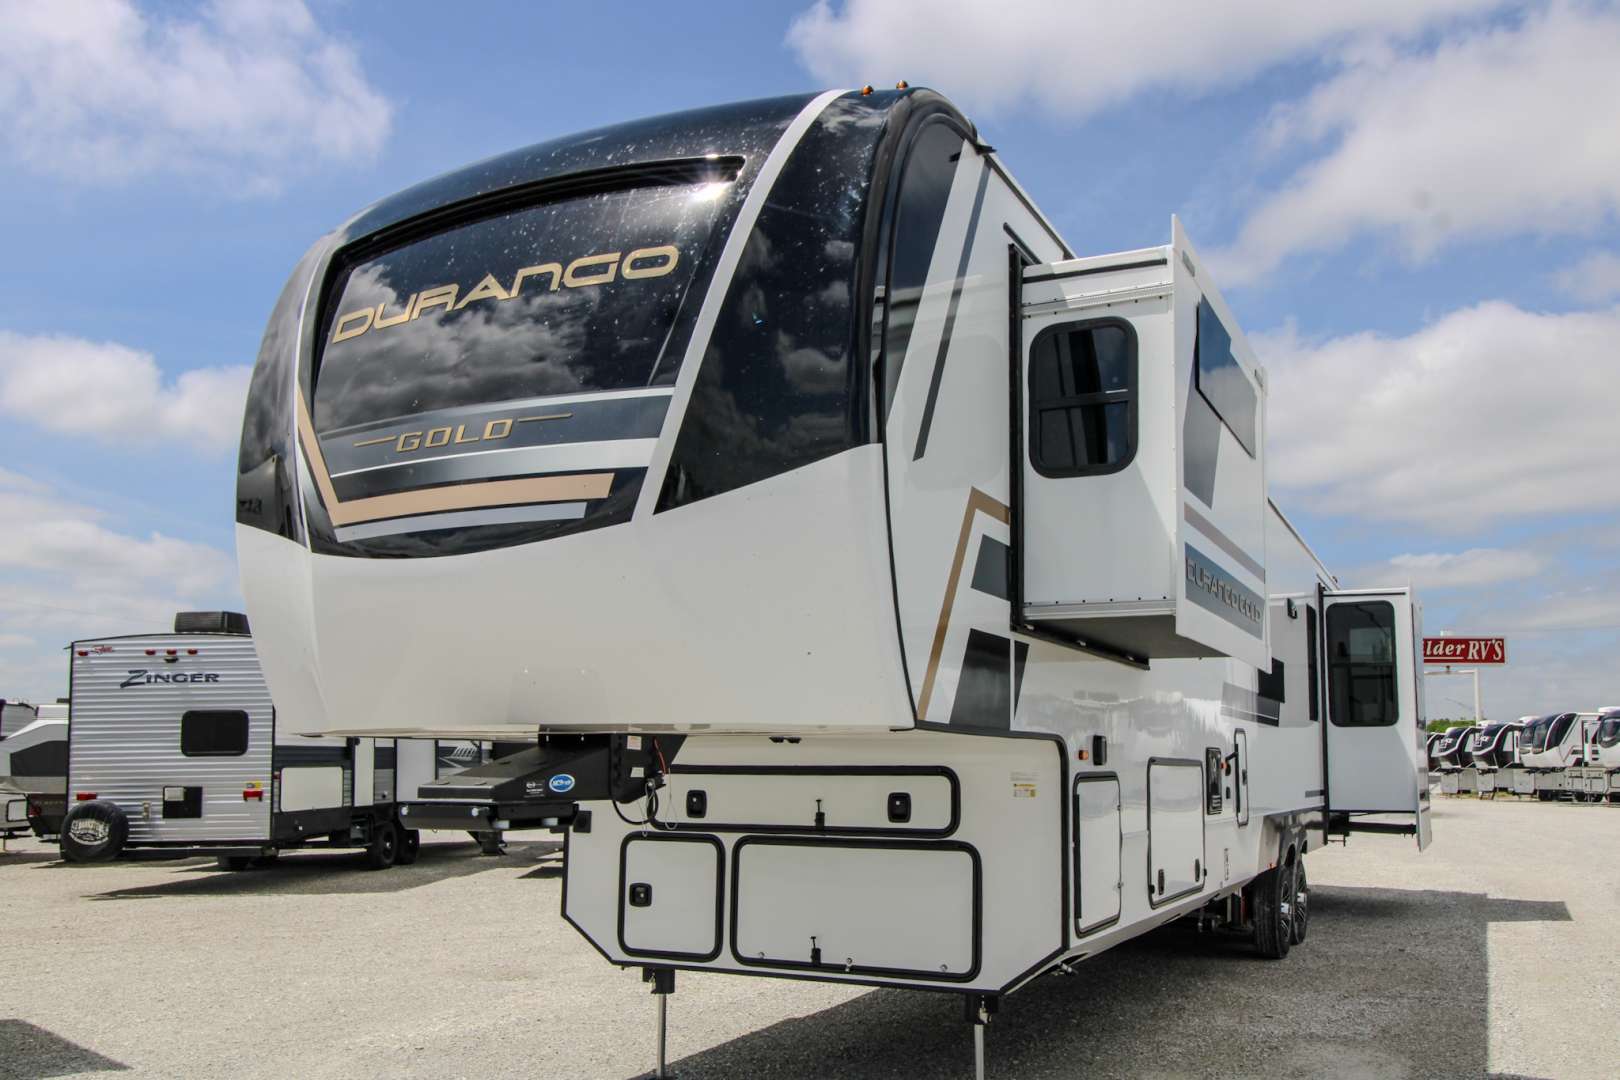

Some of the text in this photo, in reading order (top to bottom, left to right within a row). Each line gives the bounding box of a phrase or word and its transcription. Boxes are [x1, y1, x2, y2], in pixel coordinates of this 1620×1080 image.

[332, 245, 679, 343] DURANGO
[396, 418, 514, 452] GOLD
[1424, 640, 1466, 656] lder
